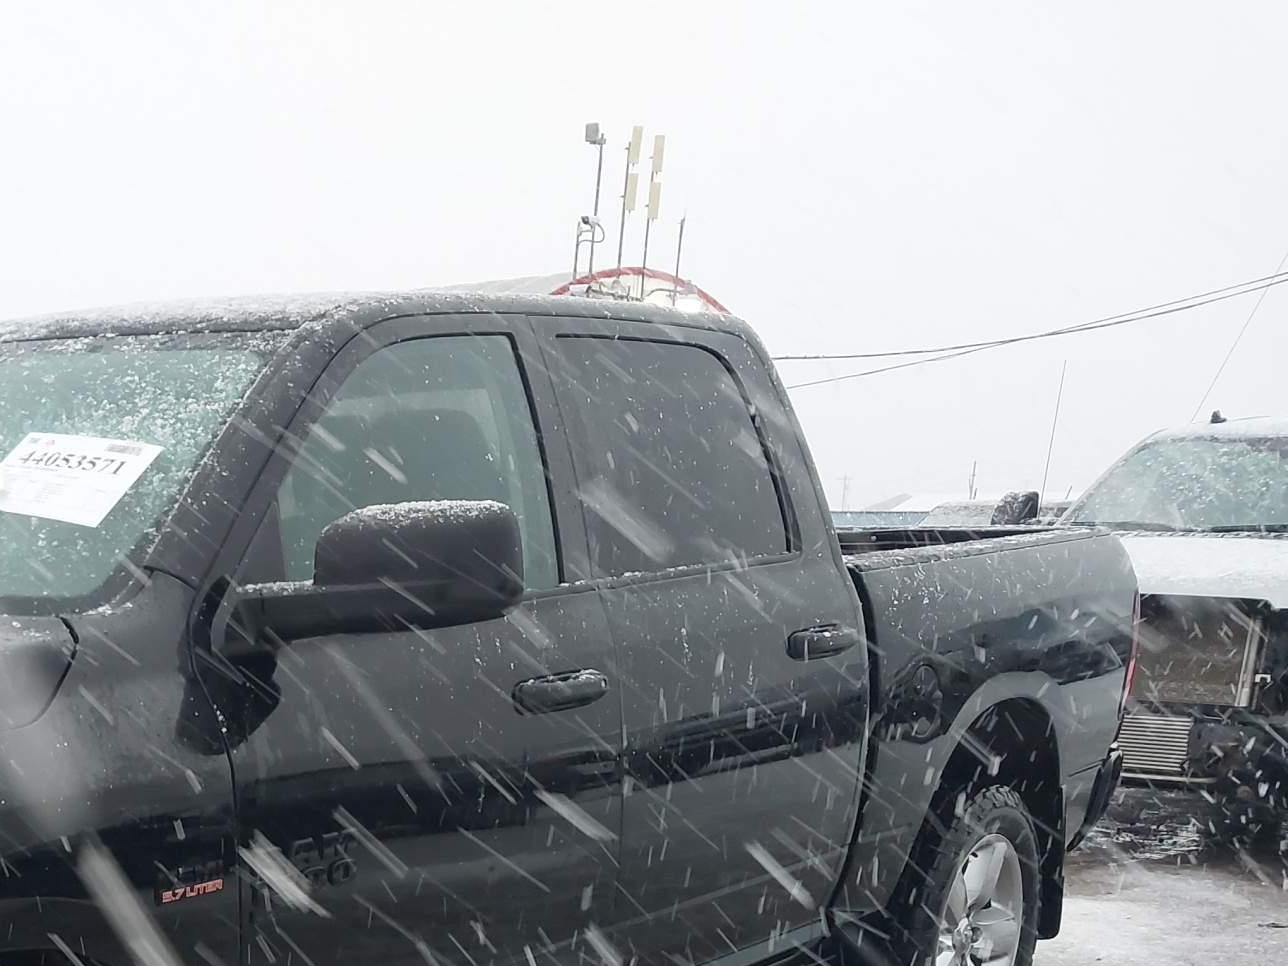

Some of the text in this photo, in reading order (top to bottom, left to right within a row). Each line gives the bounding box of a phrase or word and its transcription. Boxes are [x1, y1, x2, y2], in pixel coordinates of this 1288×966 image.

[20, 450, 127, 475] 44053571
[161, 878, 223, 904] 5.7 LITER
